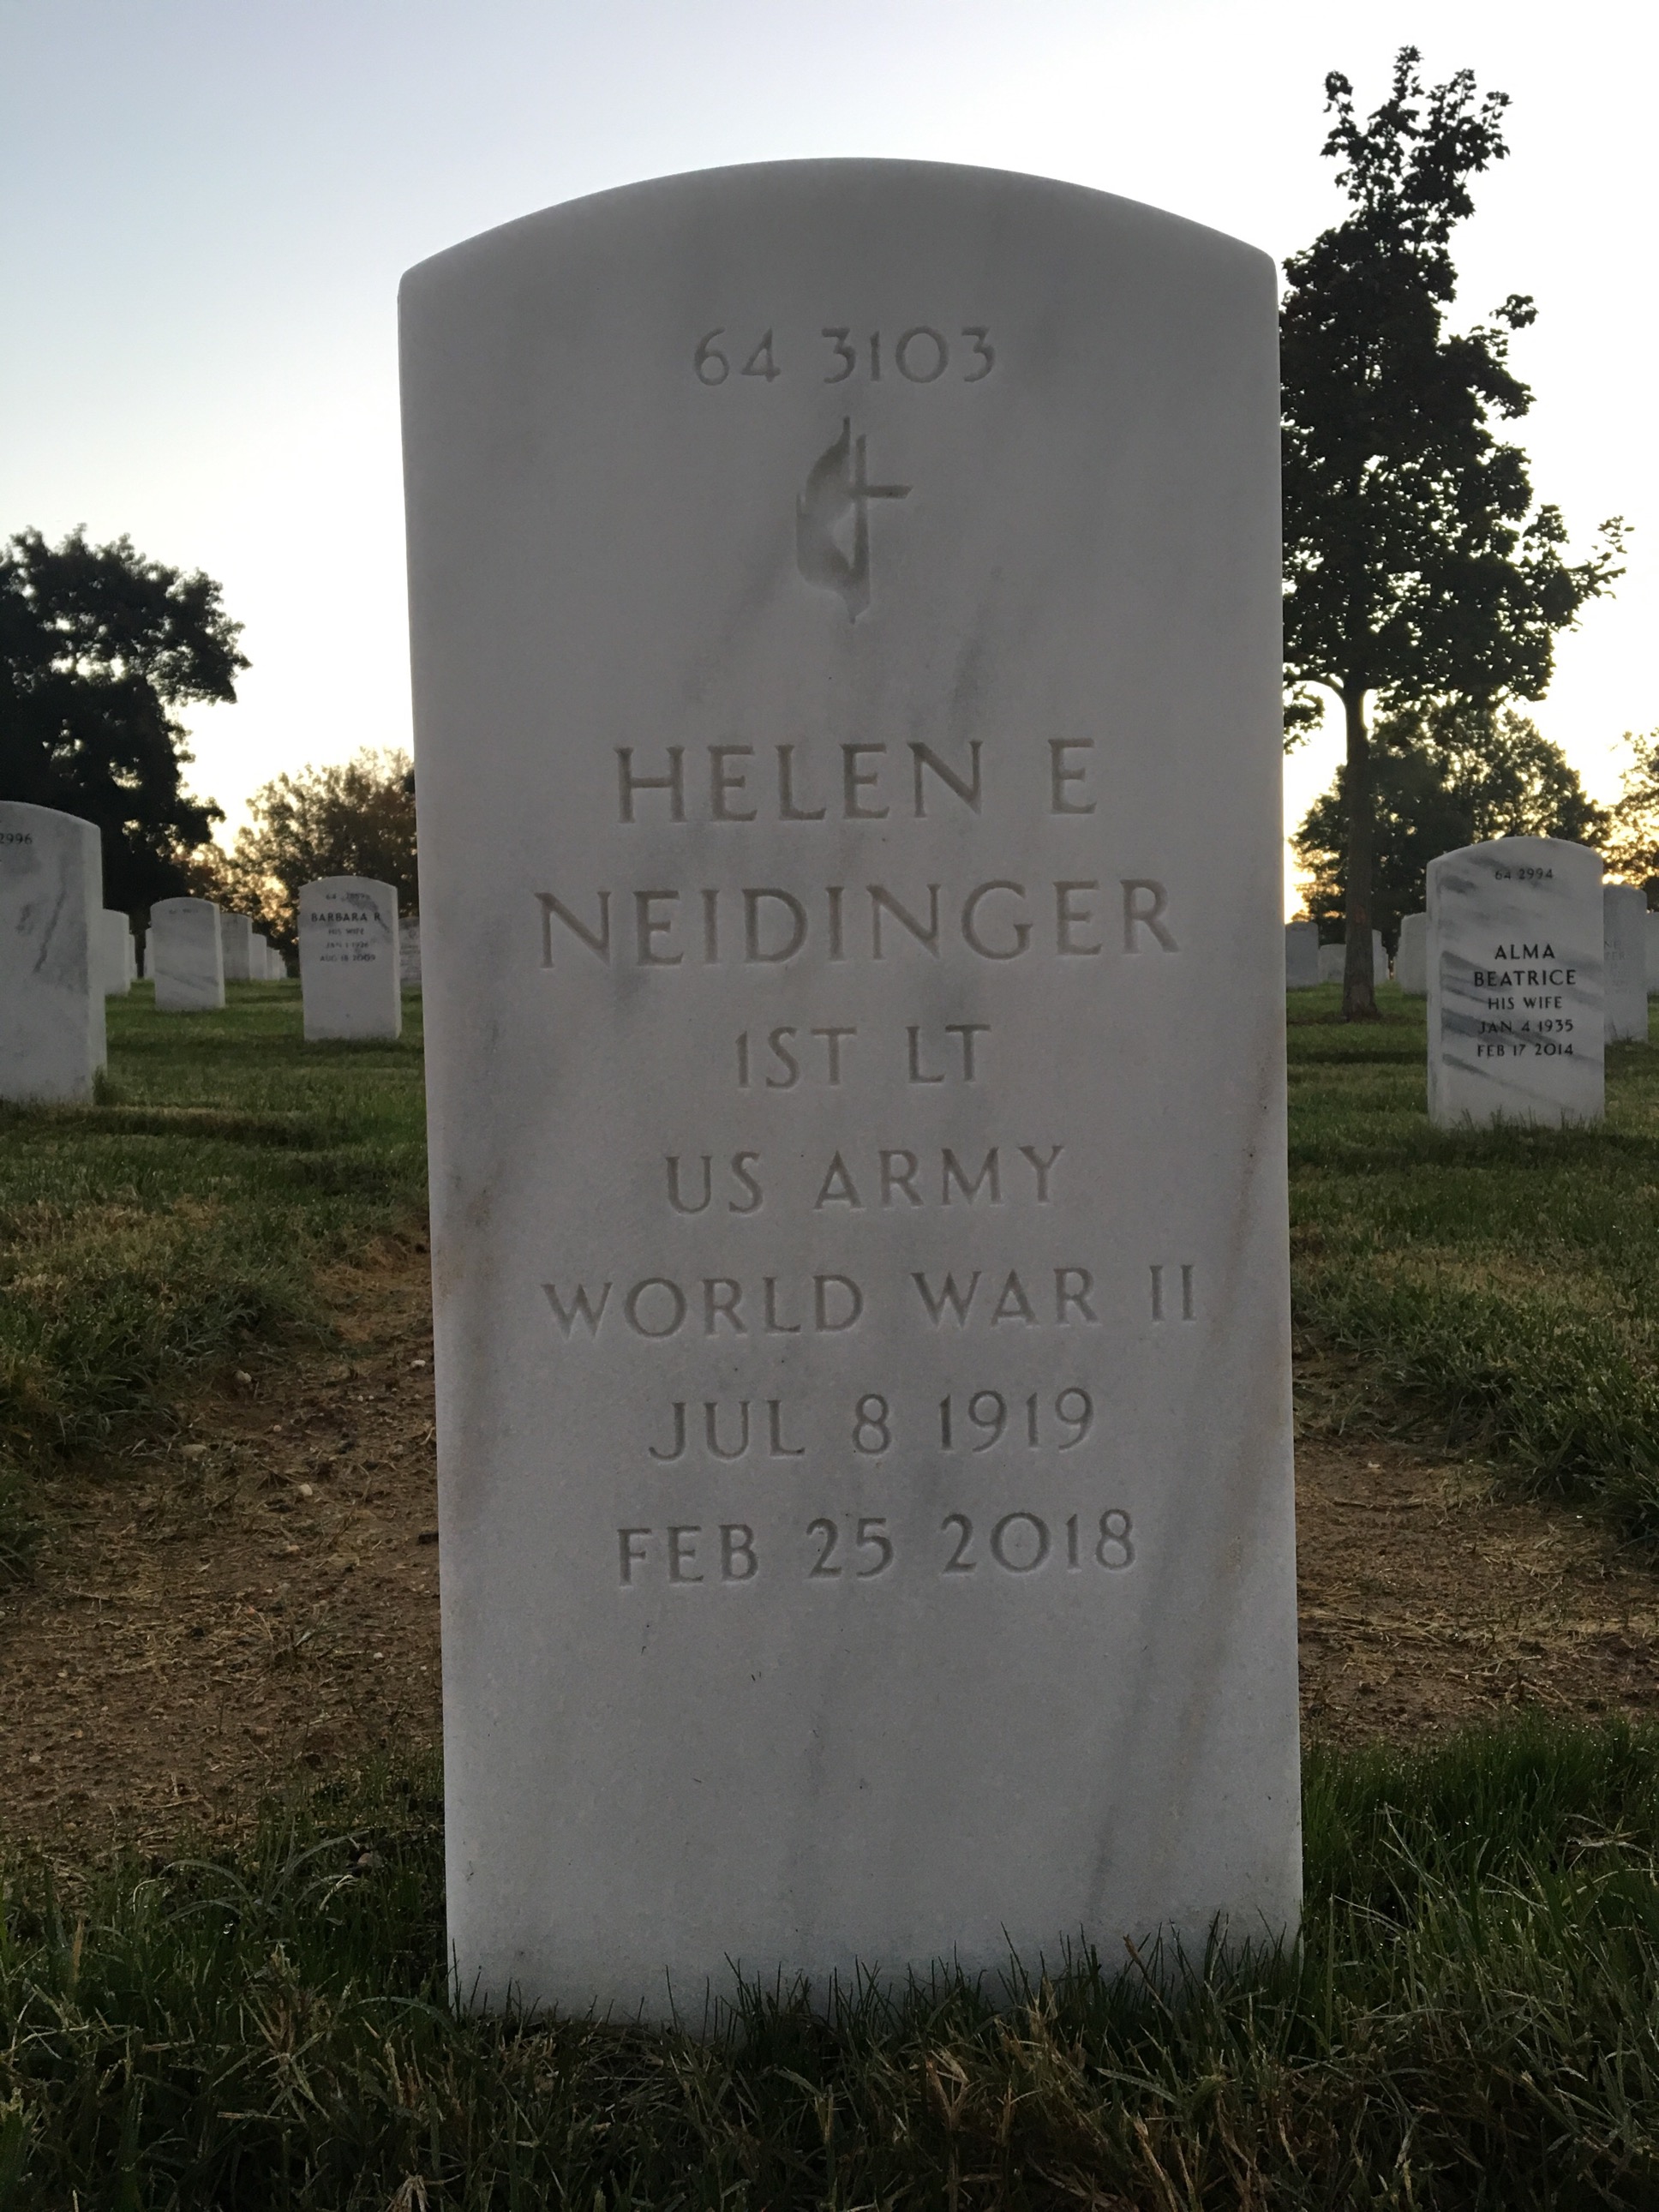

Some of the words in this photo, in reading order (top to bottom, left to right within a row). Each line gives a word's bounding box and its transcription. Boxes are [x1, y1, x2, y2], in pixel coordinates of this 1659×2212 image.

[694, 327, 781, 386] 64
[822, 326, 995, 384] 3103
[614, 740, 983, 823] HELEN
[1048, 738, 1097, 815] E
[1494, 870, 1511, 880] 64
[1518, 867, 1553, 880] 2994
[310, 912, 368, 922] BARBARA
[374, 912, 380, 921] R
[534, 878, 1180, 968] NEIDINGER
[1474, 969, 1577, 986] BEATRICE
[1494, 944, 1555, 960] ALMA
[1478, 1021, 1512, 1034] JAN
[1521, 1020, 1530, 1032] 4
[1539, 1018, 1574, 1033] 1935
[1488, 997, 1515, 1010] HIS
[1524, 996, 1563, 1010] WIFE
[735, 1027, 857, 1089] 1ST
[906, 1023, 991, 1084] LT
[1477, 1045, 1506, 1058] FEB
[1512, 1044, 1526, 1057] 17
[1535, 1043, 1573, 1056] 2014
[665, 1151, 764, 1215] US
[813, 1145, 1064, 1211] ARMY
[541, 1274, 864, 1340] WORLD
[911, 1267, 1101, 1329] WAR
[1149, 1263, 1196, 1324] II
[648, 1399, 806, 1462] JUL
[851, 1393, 892, 1455] 8
[938, 1387, 1094, 1453] 1919
[616, 1523, 758, 1586] FEB
[805, 1516, 894, 1580] 25
[939, 1508, 1136, 1574] 2018
